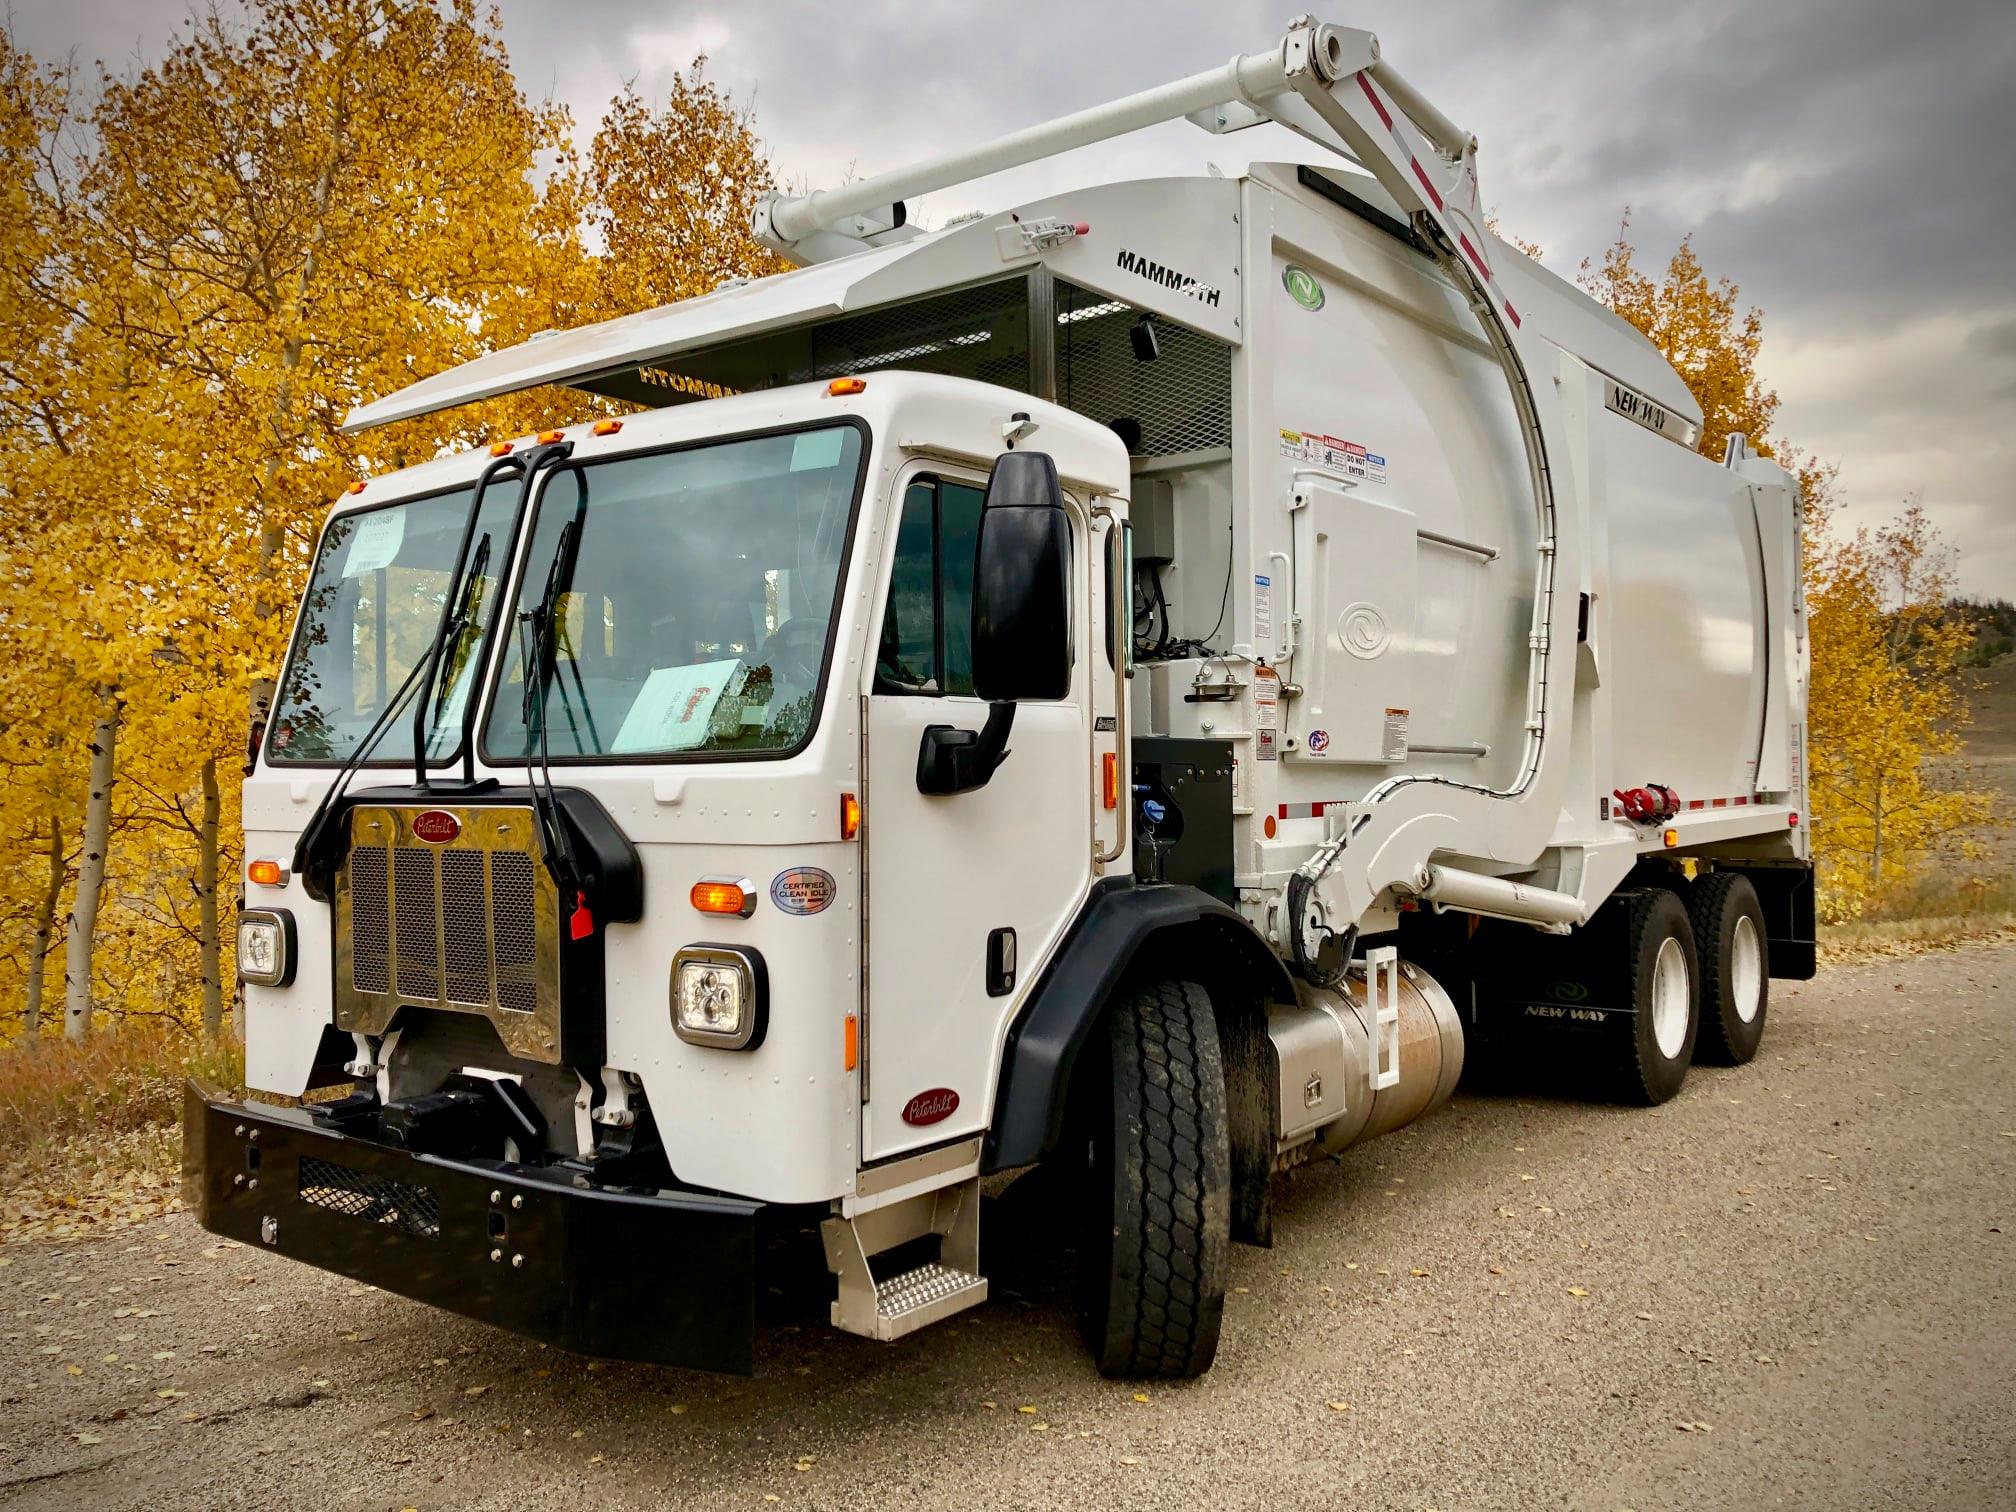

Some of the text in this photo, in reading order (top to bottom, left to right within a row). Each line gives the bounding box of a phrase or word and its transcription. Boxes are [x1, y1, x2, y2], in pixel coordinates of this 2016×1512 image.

[1117, 249, 1221, 308] MAMMOTH
[1612, 386, 1639, 416] NEW
[1347, 455, 1365, 467] DO NOT
[1348, 466, 1365, 476] ENTER
[417, 816, 454, 835] Peterbilt
[782, 881, 825, 890] CERTIFIED
[810, 889, 829, 897] IDLE
[1525, 1005, 1609, 1022] NEW WAY
[909, 1093, 956, 1122] Peterbilt
